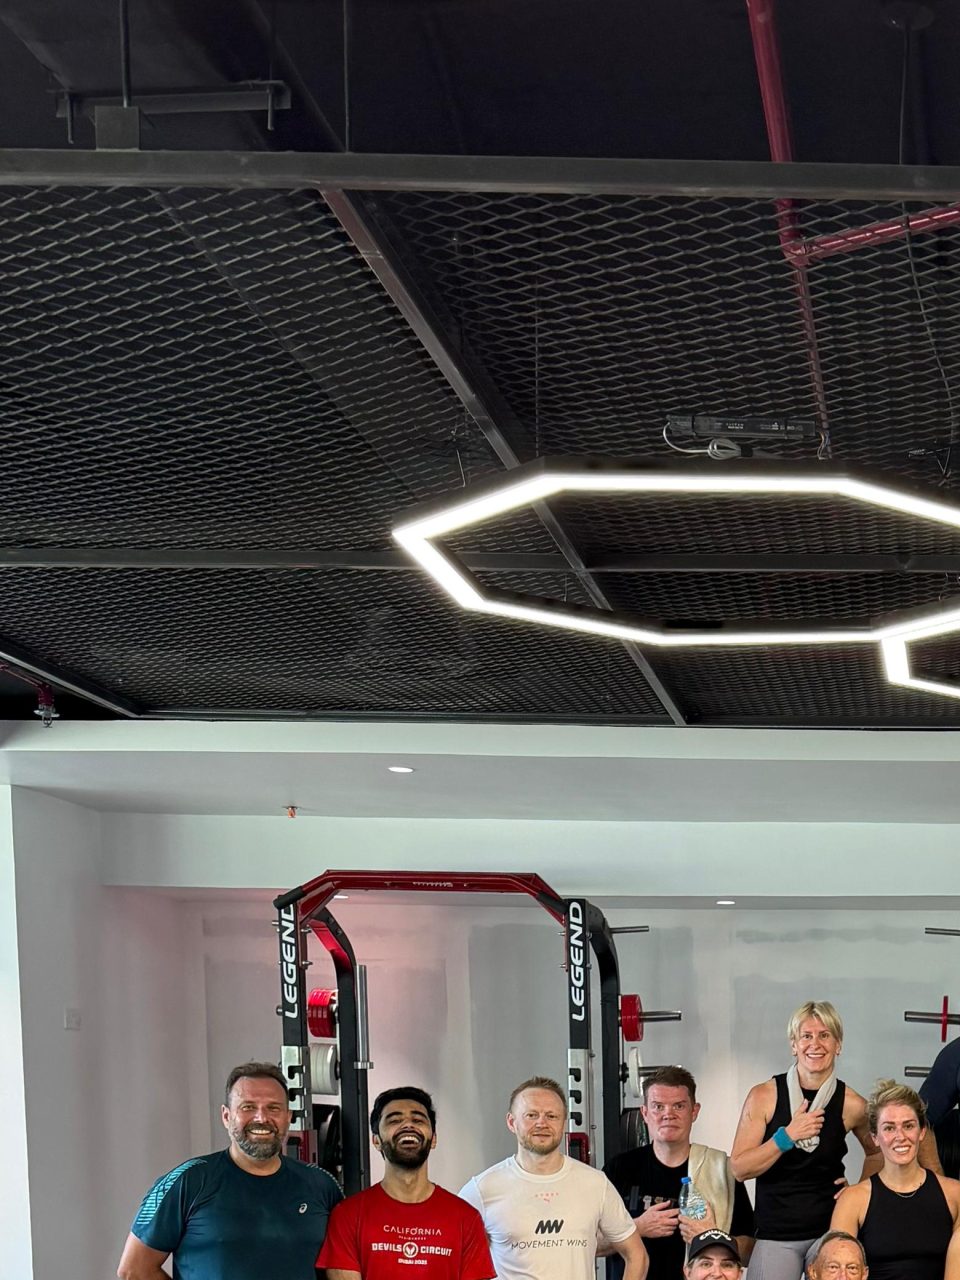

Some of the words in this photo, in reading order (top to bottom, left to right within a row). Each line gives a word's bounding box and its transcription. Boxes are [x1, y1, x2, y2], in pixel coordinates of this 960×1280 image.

[568, 901, 586, 1022] LEGEND
[383, 1225, 442, 1237] CALIFORNIA
[371, 1242, 402, 1253] DEVILS
[420, 1247, 453, 1257] CIRCUIT
[511, 1239, 564, 1251] MOVEMENT
[566, 1239, 588, 1248] WINS
